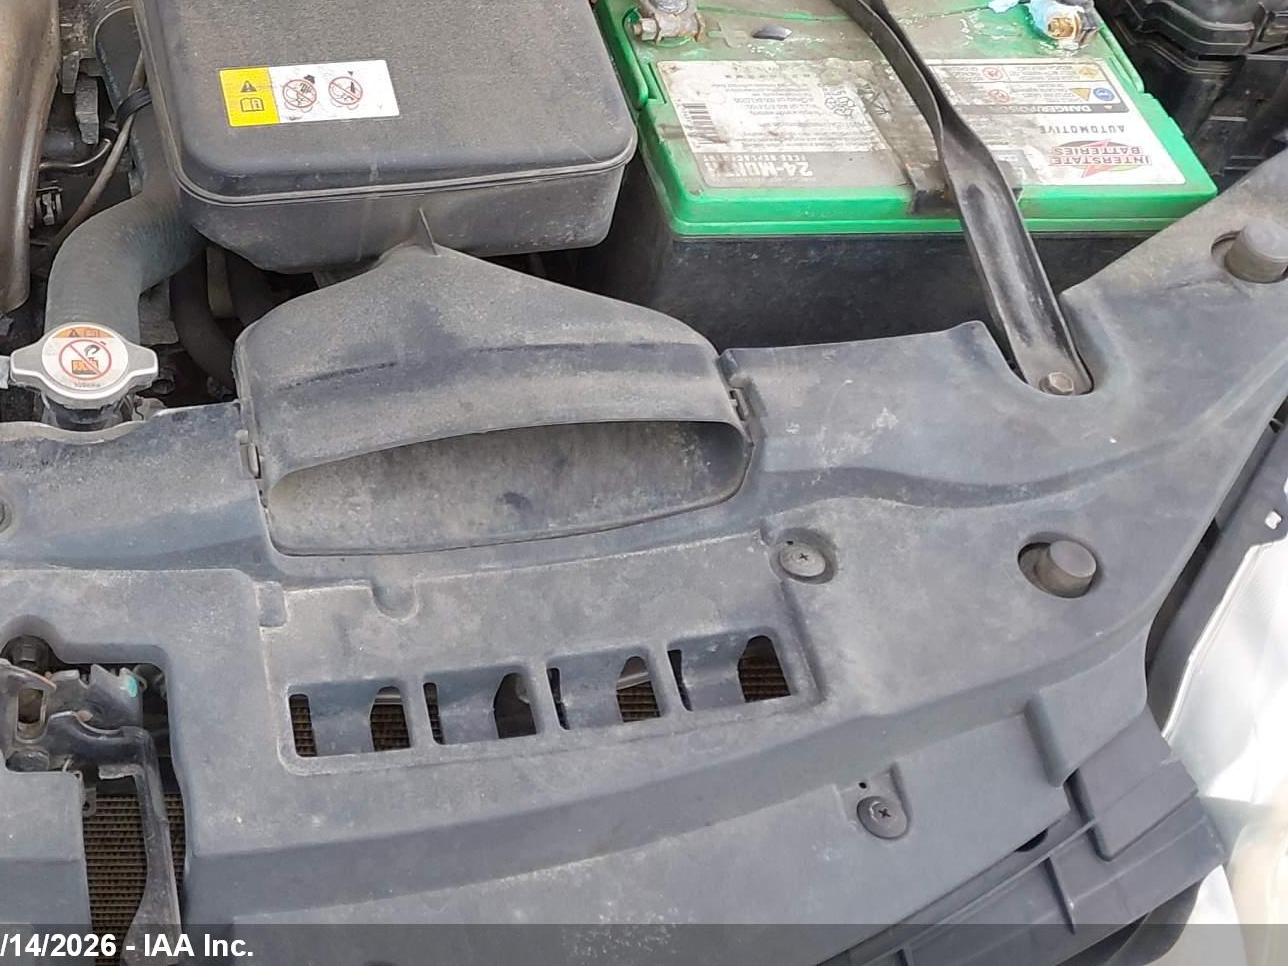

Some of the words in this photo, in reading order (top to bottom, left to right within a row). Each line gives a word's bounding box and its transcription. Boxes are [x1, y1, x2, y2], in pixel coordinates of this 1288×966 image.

[992, 105, 1093, 113] DANGER/POISO
[1039, 124, 1126, 135] AUTOMOTIVE
[1054, 146, 1142, 155] BATTERIES
[1051, 155, 1150, 165] INTERSTATE
[705, 161, 814, 177] 24-MONH
